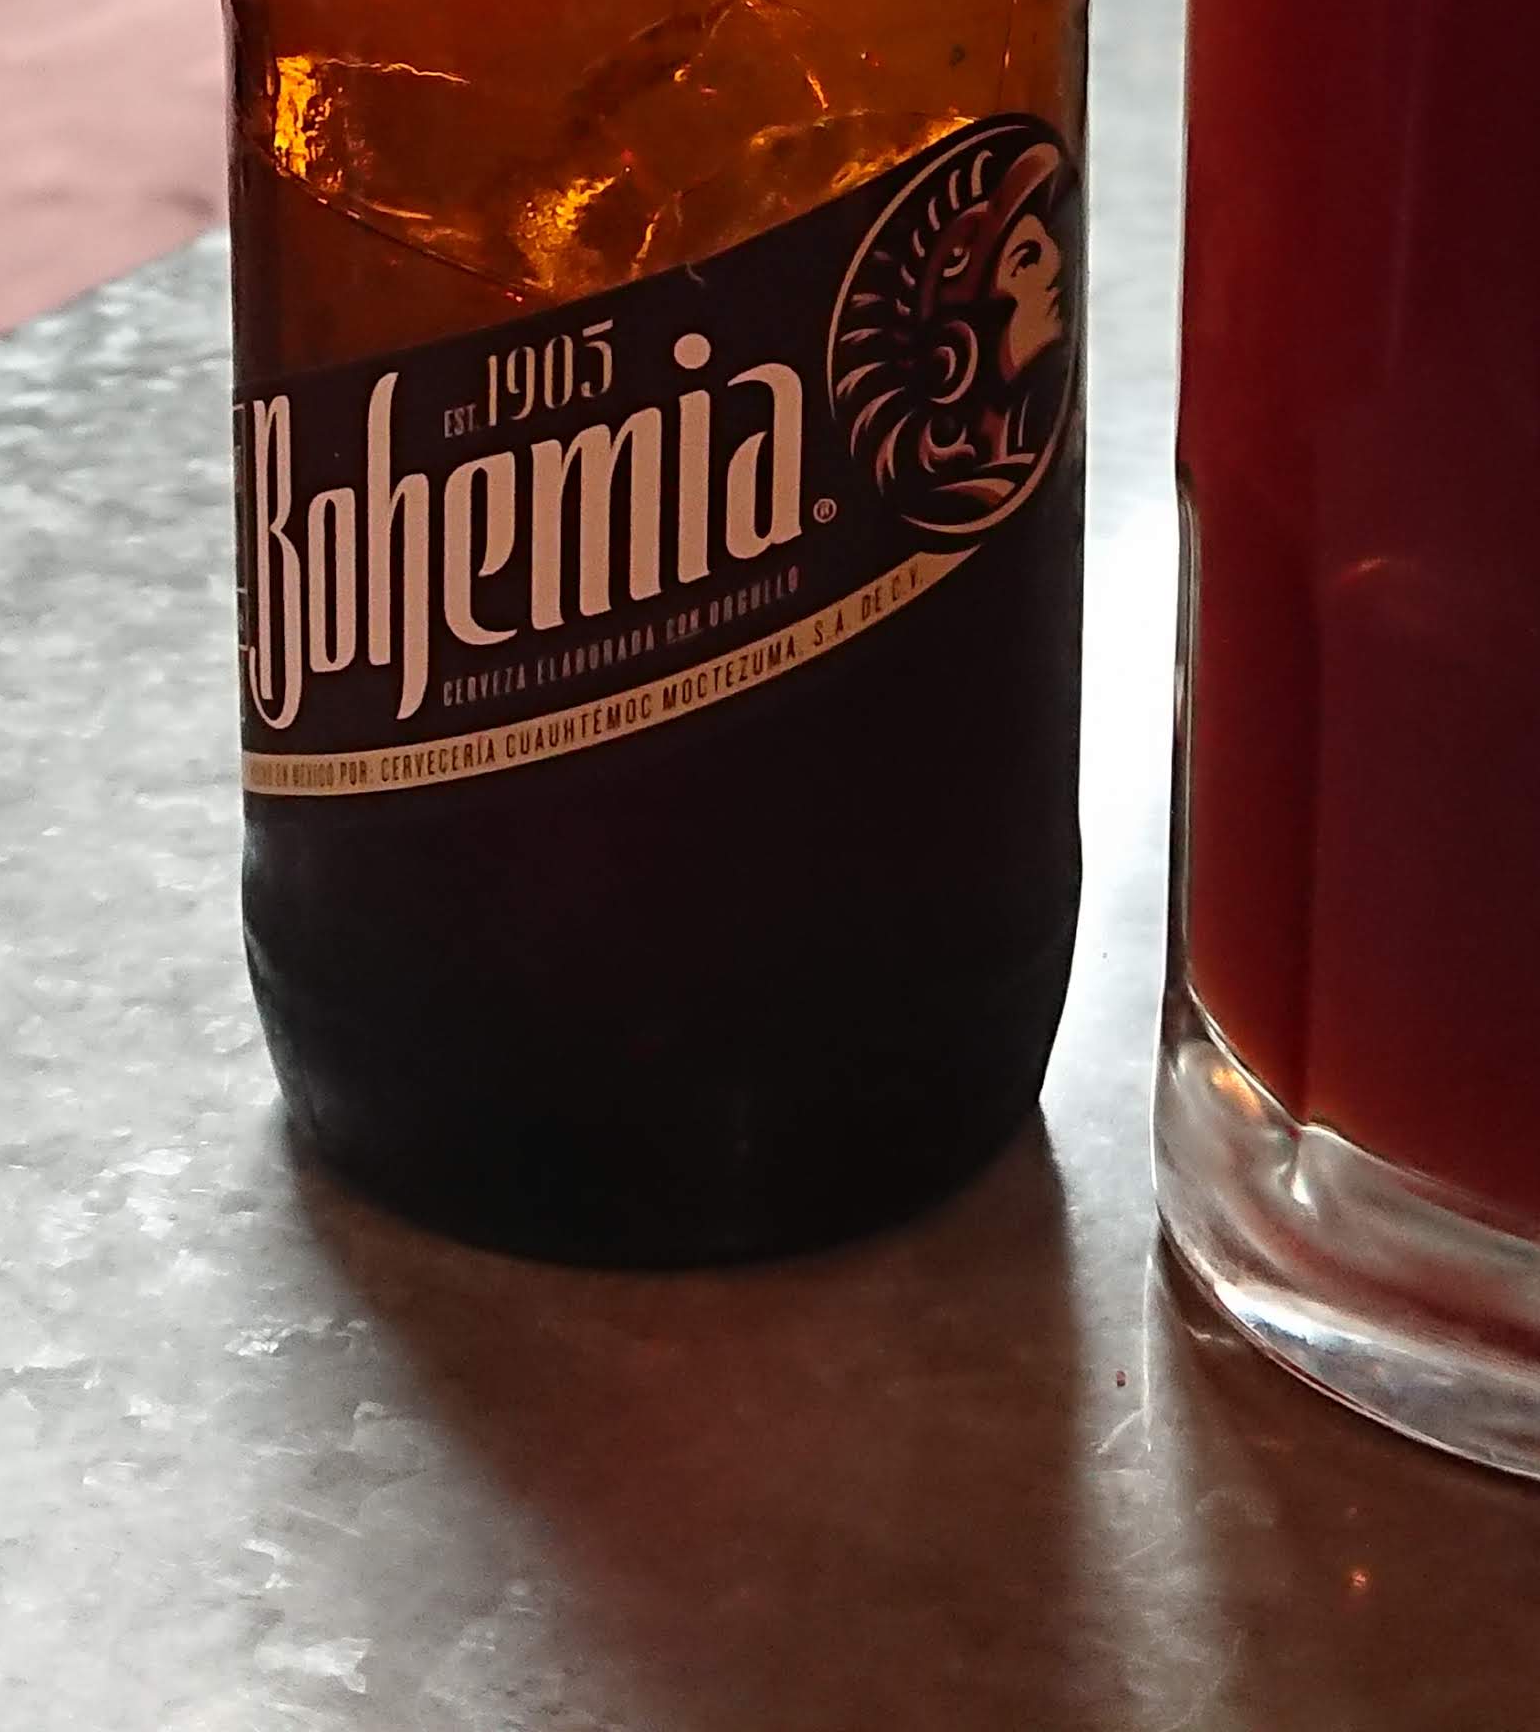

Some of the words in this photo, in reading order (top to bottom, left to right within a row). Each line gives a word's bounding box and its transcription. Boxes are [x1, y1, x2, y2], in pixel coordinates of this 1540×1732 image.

[488, 319, 614, 427] 1905
[247, 333, 804, 730] Bohemia
[381, 736, 496, 783] CERVECERÍA
[506, 693, 652, 759] CUAUHTÉMOC
[862, 586, 882, 621] DE
[443, 662, 526, 707] CERVEZA
[537, 624, 655, 685] ELABORADA
